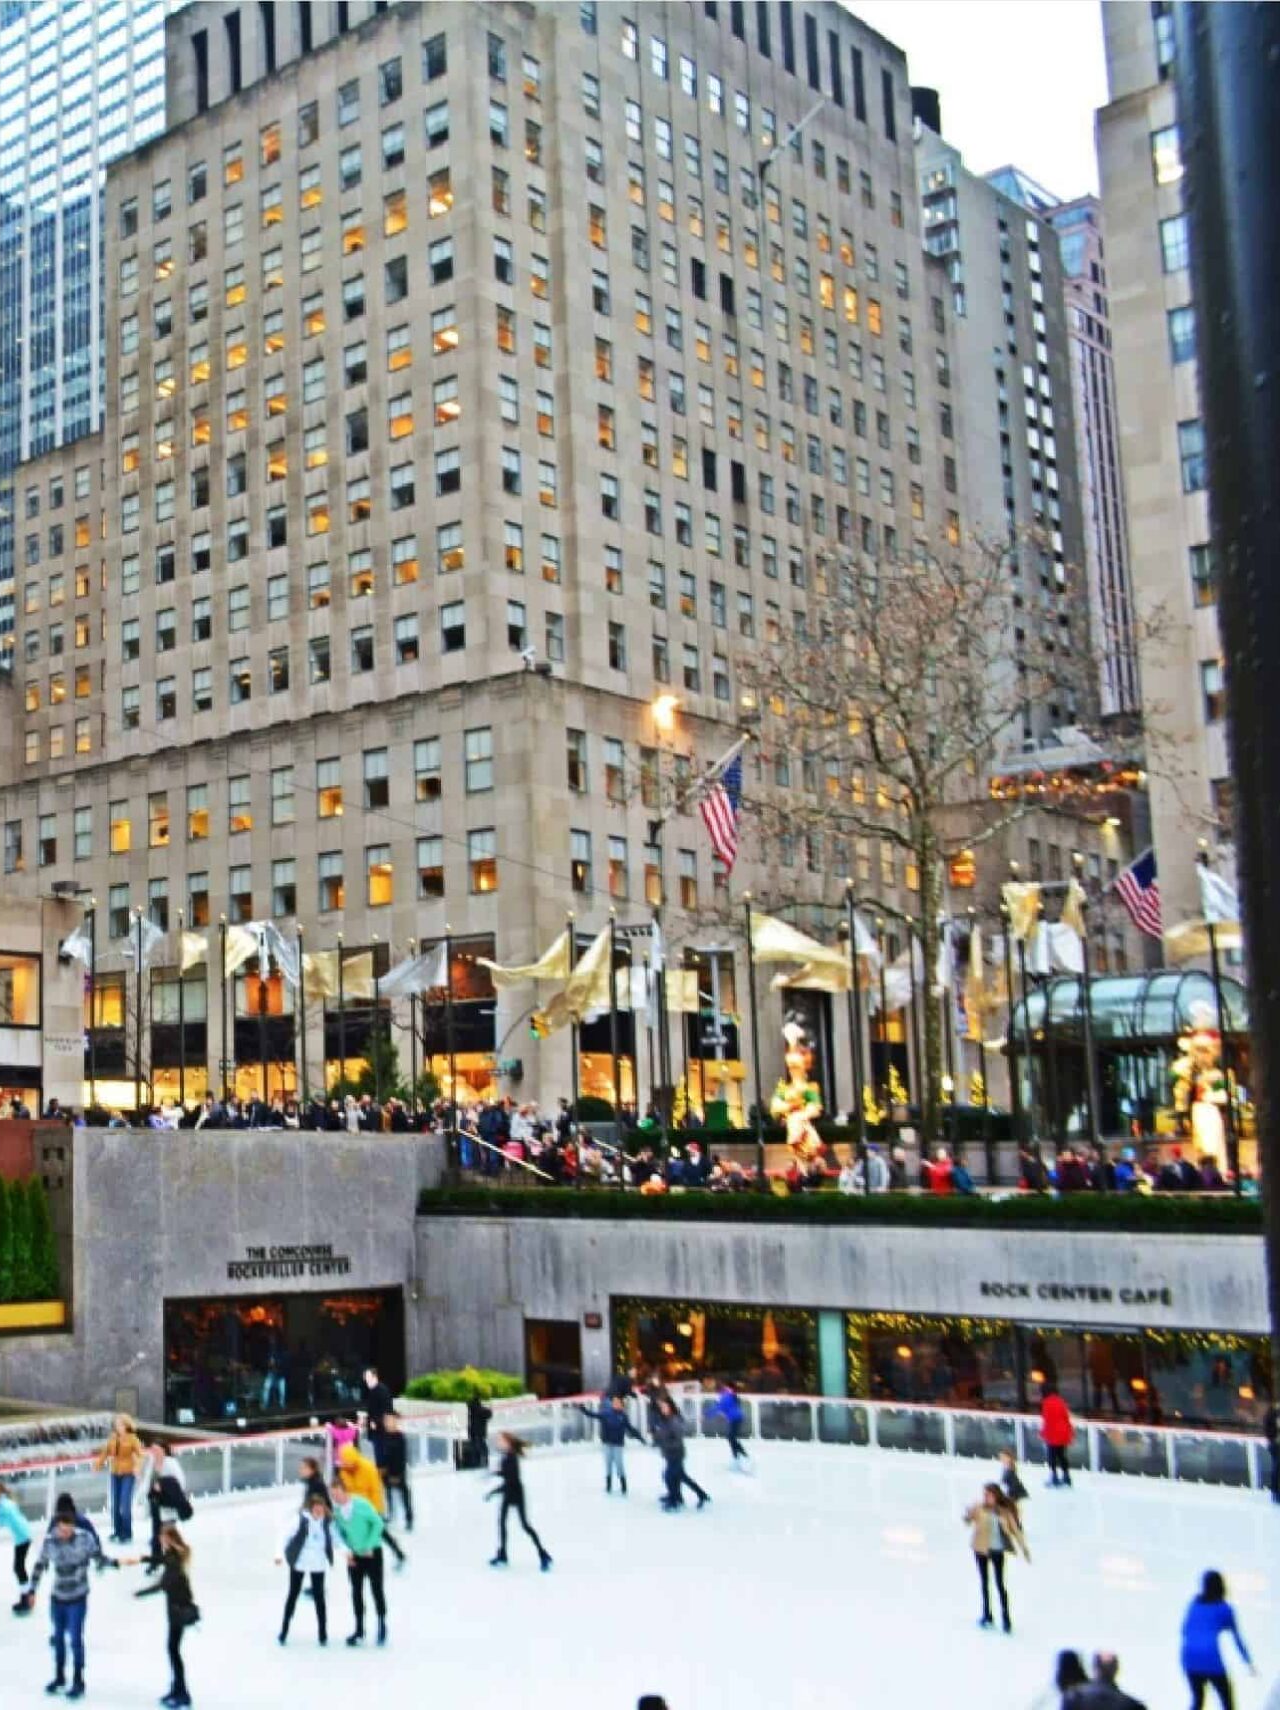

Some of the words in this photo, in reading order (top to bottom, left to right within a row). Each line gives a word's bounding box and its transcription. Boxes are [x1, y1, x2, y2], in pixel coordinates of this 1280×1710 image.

[246, 1246, 266, 1259] THE
[310, 1257, 351, 1276] CENTER
[980, 1281, 1030, 1298] ROCK
[1036, 1283, 1113, 1303] CENTER
